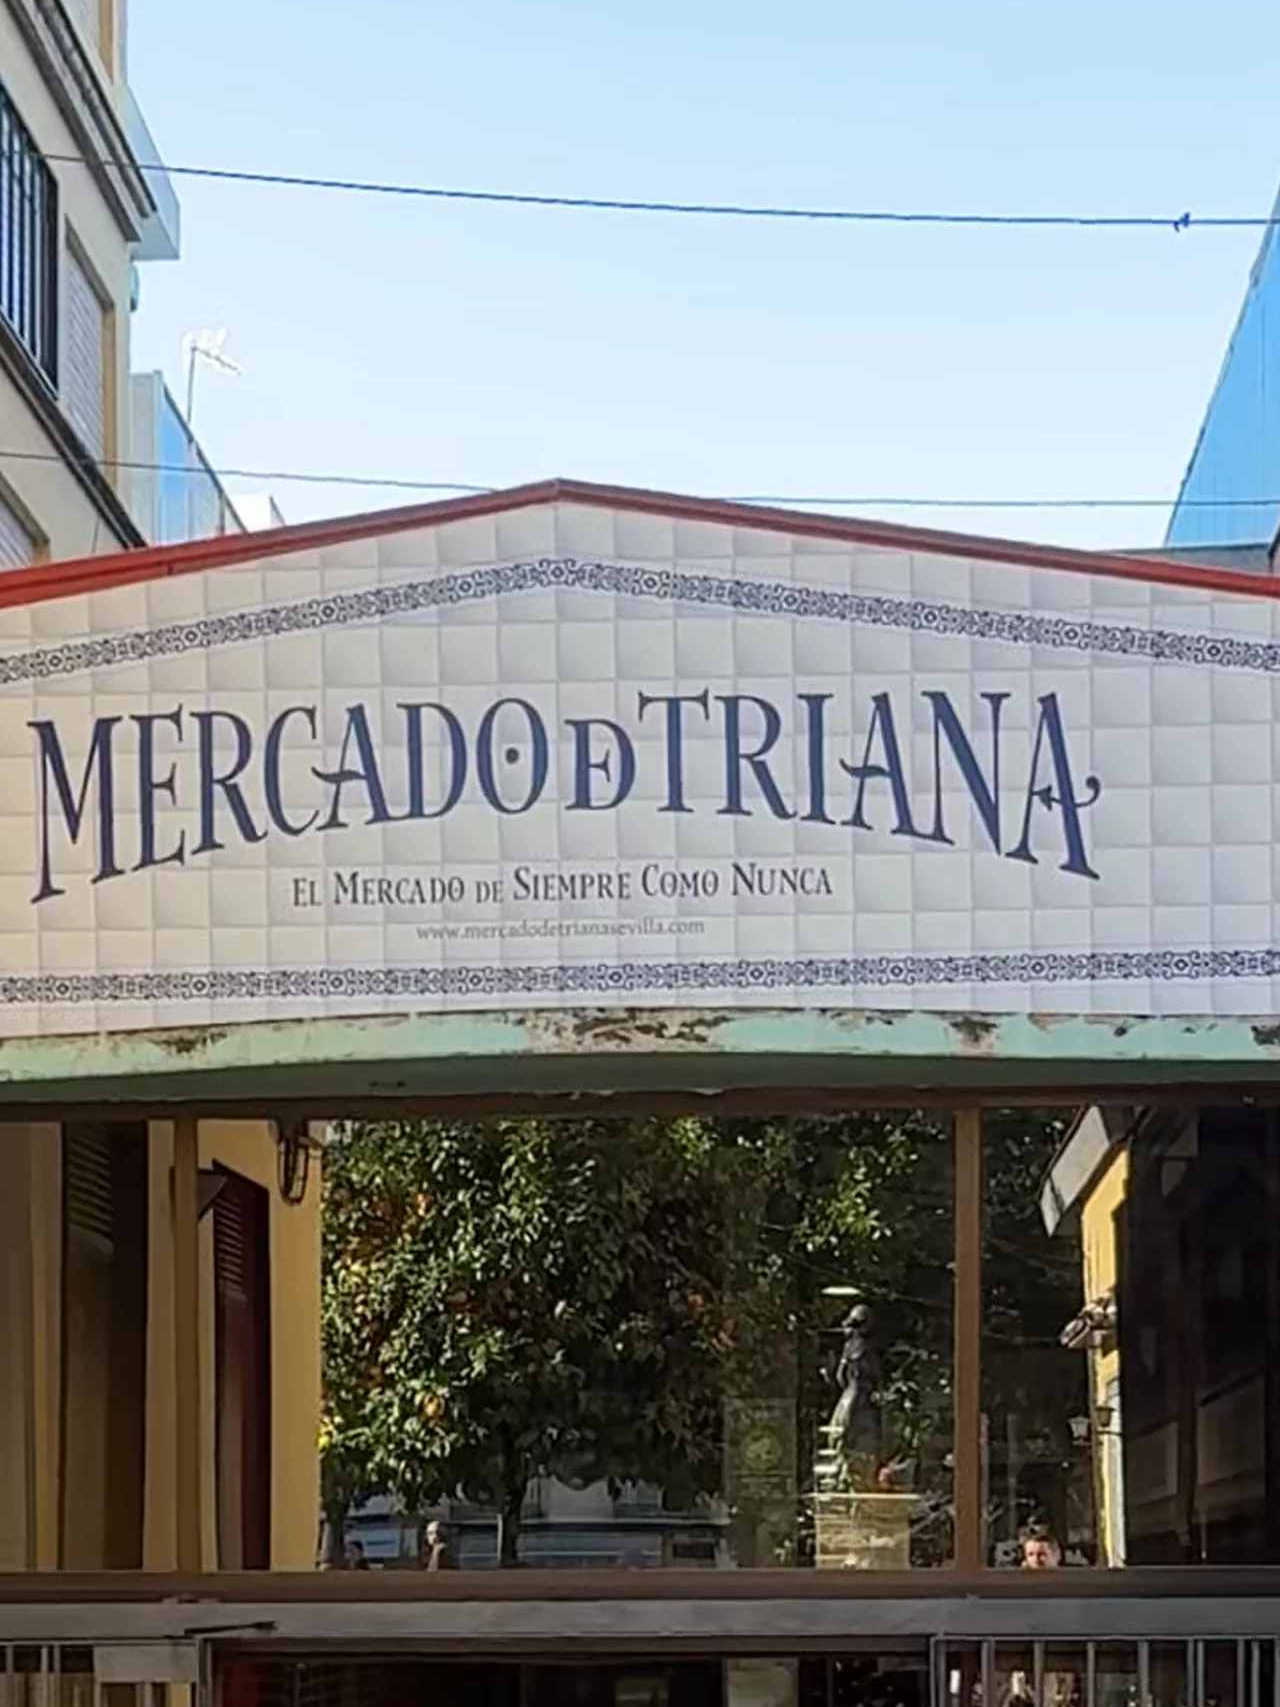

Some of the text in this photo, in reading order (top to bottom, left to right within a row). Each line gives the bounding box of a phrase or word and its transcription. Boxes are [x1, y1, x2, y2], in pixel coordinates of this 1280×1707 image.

[26, 696, 549, 905] MERCADO
[637, 687, 1102, 881] TRIANA
[292, 861, 834, 907] EL MERCADO DE SIEMPRE COMO NUNCA
[416, 915, 706, 941] www.mercadodetrianasevilla.com
